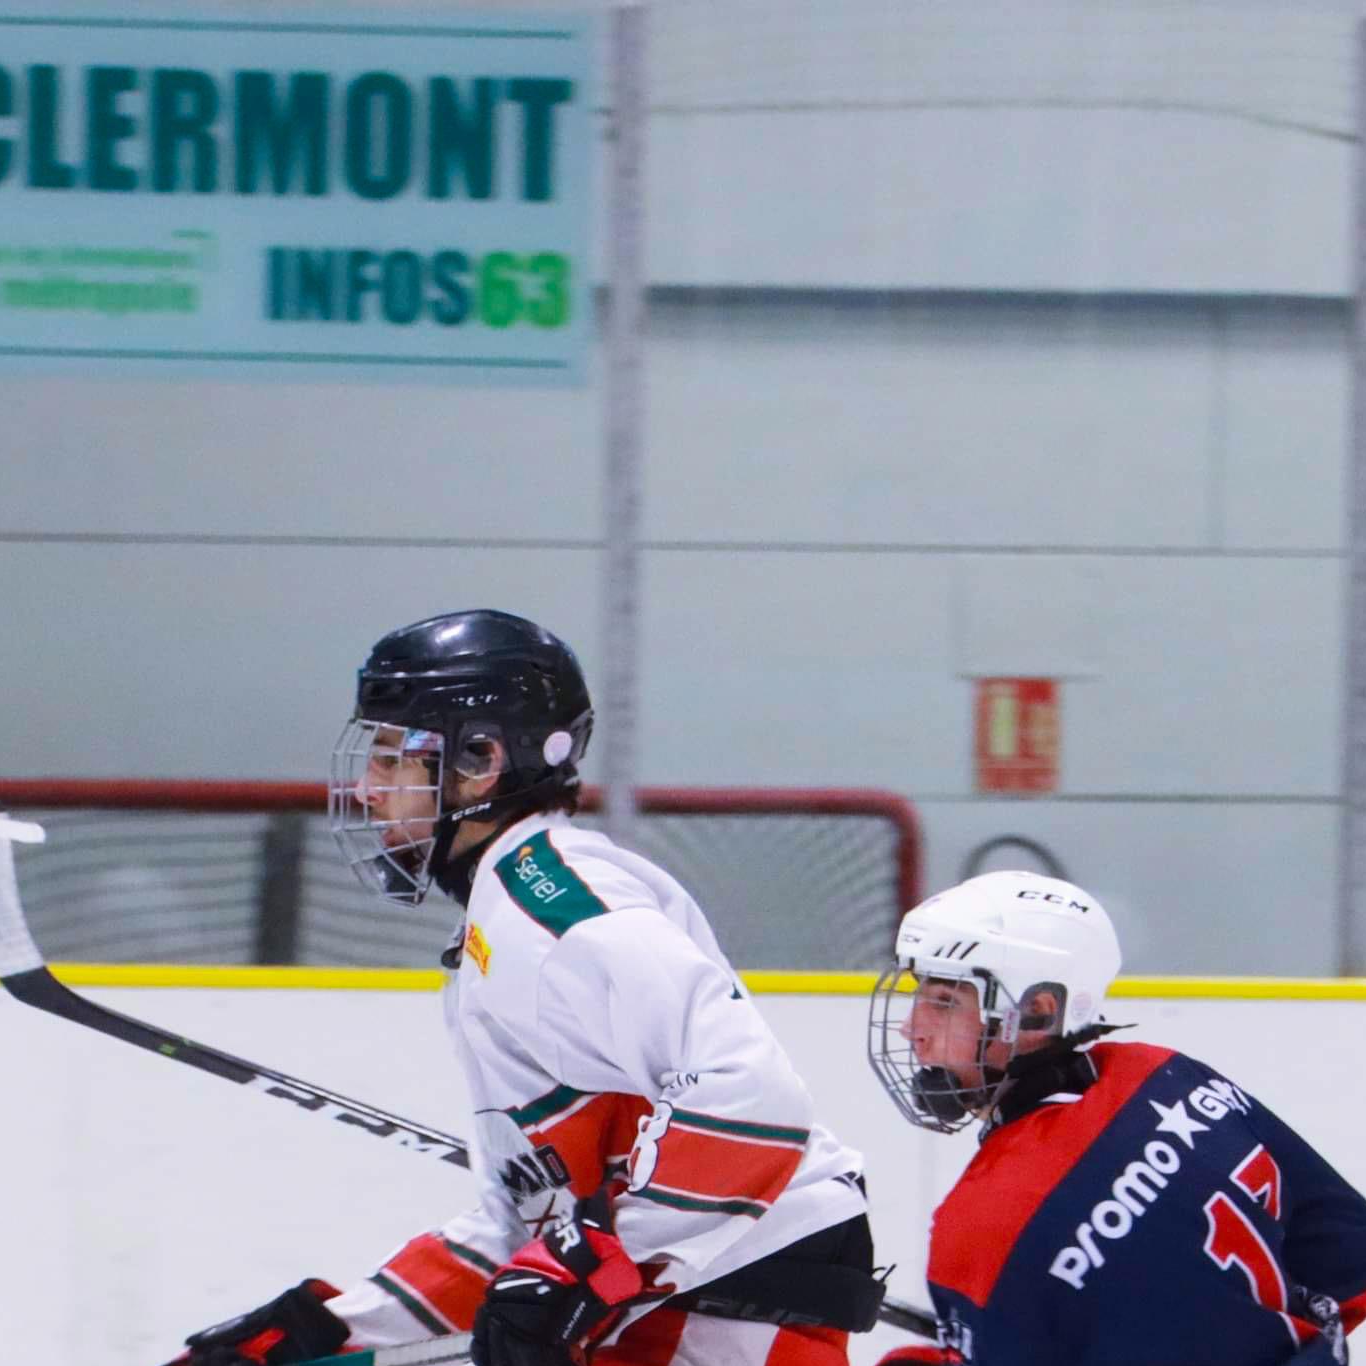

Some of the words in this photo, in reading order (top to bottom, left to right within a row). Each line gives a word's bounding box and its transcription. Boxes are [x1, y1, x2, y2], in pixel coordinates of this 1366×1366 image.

[264, 246, 570, 329] INFOS63
[1016, 889, 1090, 914] CCM
[1048, 1140, 1181, 1290] promo
